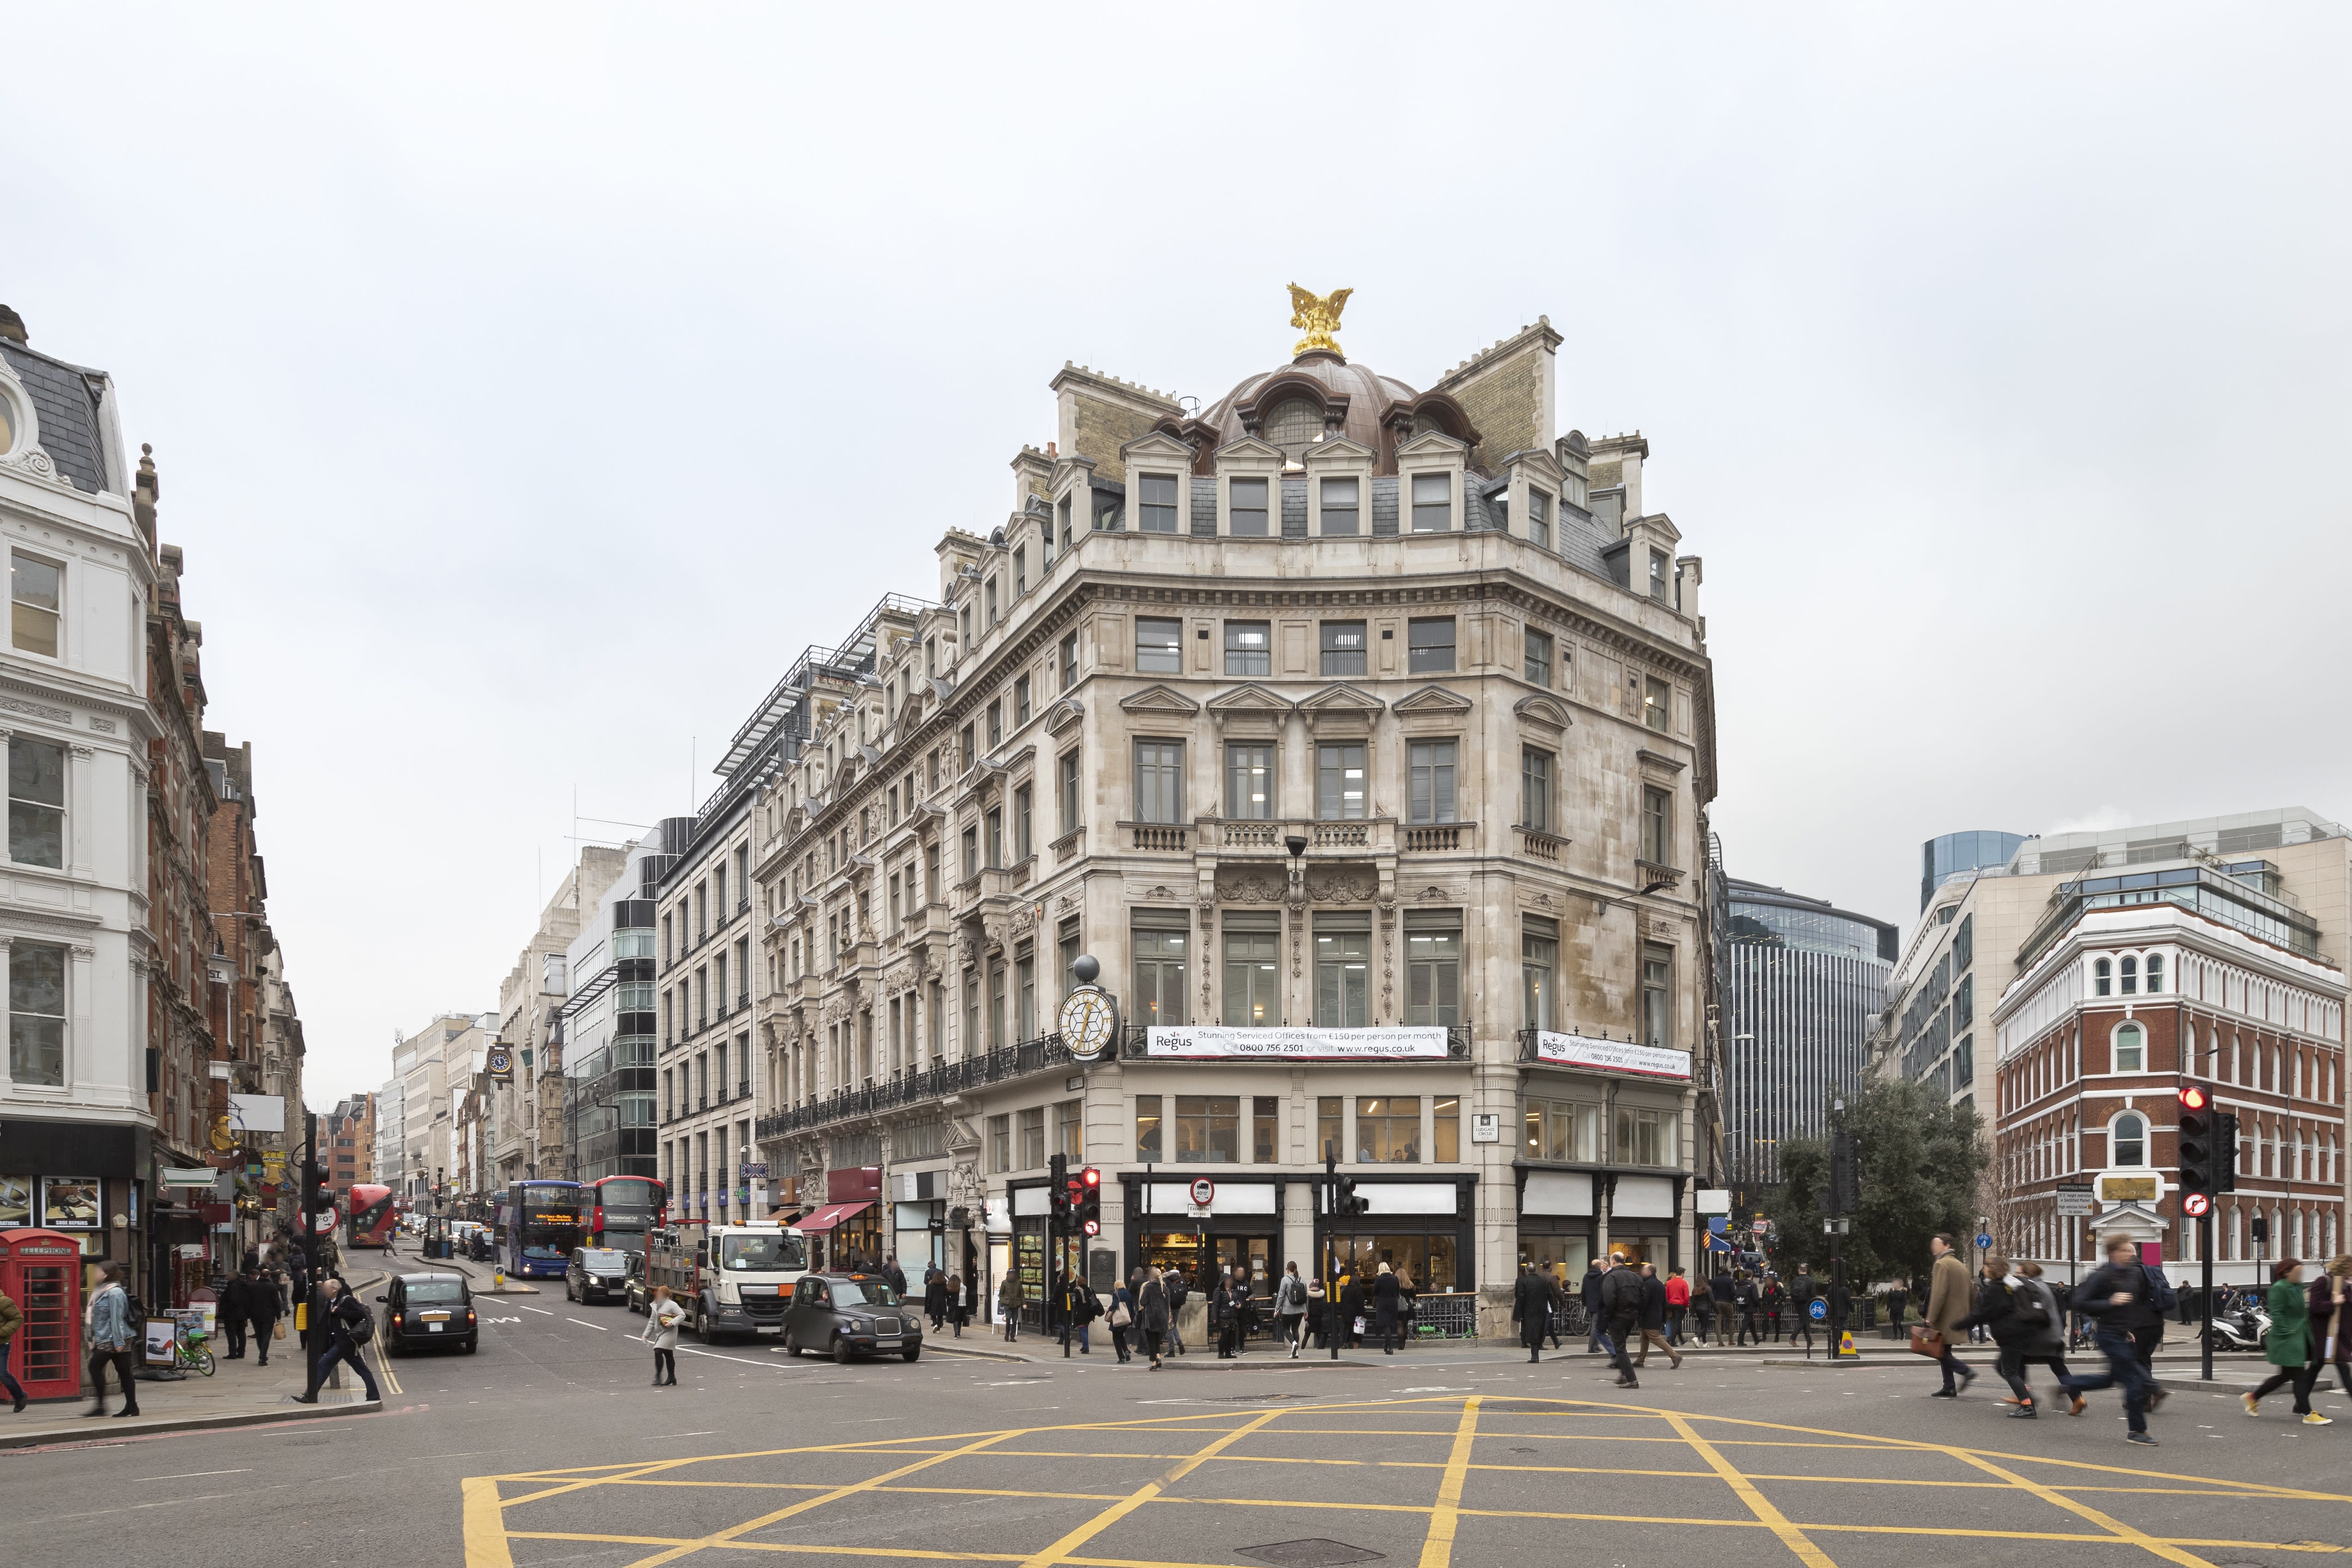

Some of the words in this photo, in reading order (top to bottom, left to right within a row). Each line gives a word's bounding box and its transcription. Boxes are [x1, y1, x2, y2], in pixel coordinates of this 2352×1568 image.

[1062, 993, 1111, 1028] LUDGATE
[1064, 1028, 1109, 1052] HOUSE
[1156, 1036, 1192, 1051] Regus
[1198, 1031, 1235, 1040] Stunning
[1338, 1044, 1416, 1054] www.regus.co.uk
[1543, 1039, 1565, 1056] Regus
[1570, 1040, 1589, 1050] Stunning
[1589, 1043, 1608, 1052] Serviced
[1608, 1045, 1624, 1054] Offices
[1674, 1054, 1687, 1062] month
[1638, 1060, 1675, 1070] www.regus.co.uk
